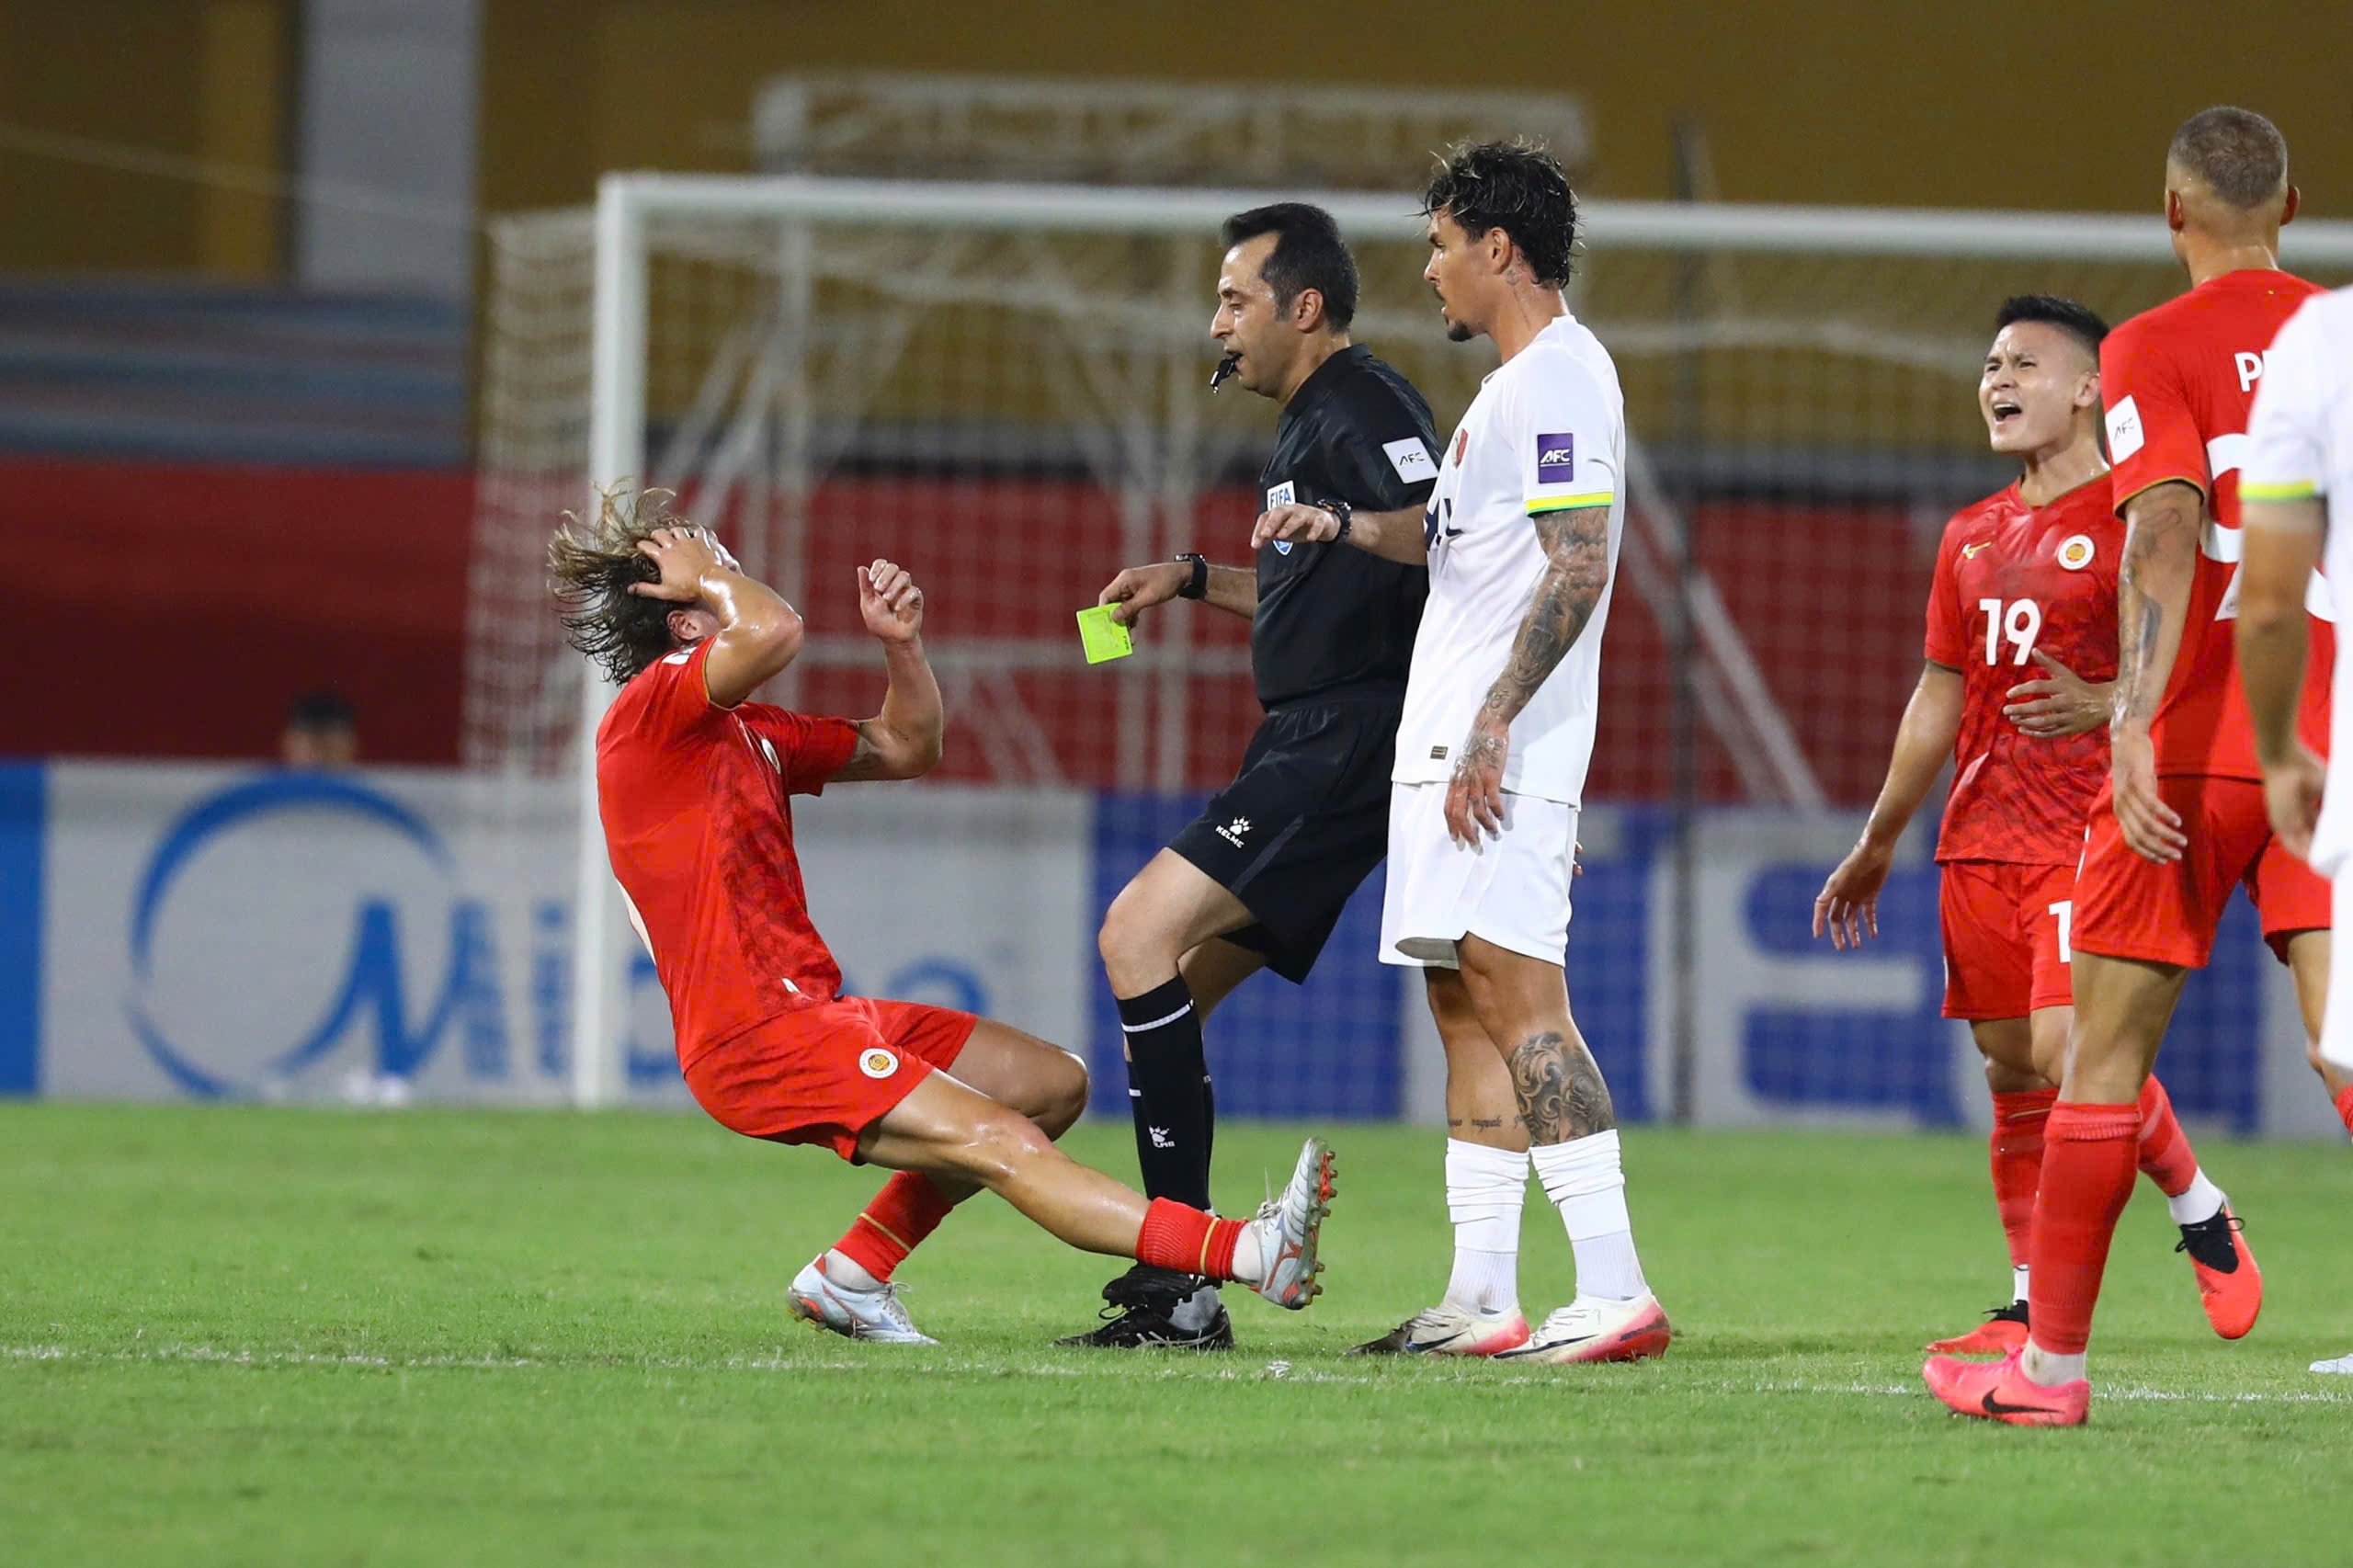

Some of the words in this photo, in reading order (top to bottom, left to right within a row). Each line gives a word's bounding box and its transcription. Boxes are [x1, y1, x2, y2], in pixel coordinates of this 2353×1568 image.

[2114, 416, 2134, 442] AFC
[1399, 451, 1425, 466] AFC
[1540, 449, 1571, 464] AFC
[1270, 487, 1291, 509] FIFA
[1979, 597, 2041, 666] 19
[1215, 824, 1245, 849] KELME
